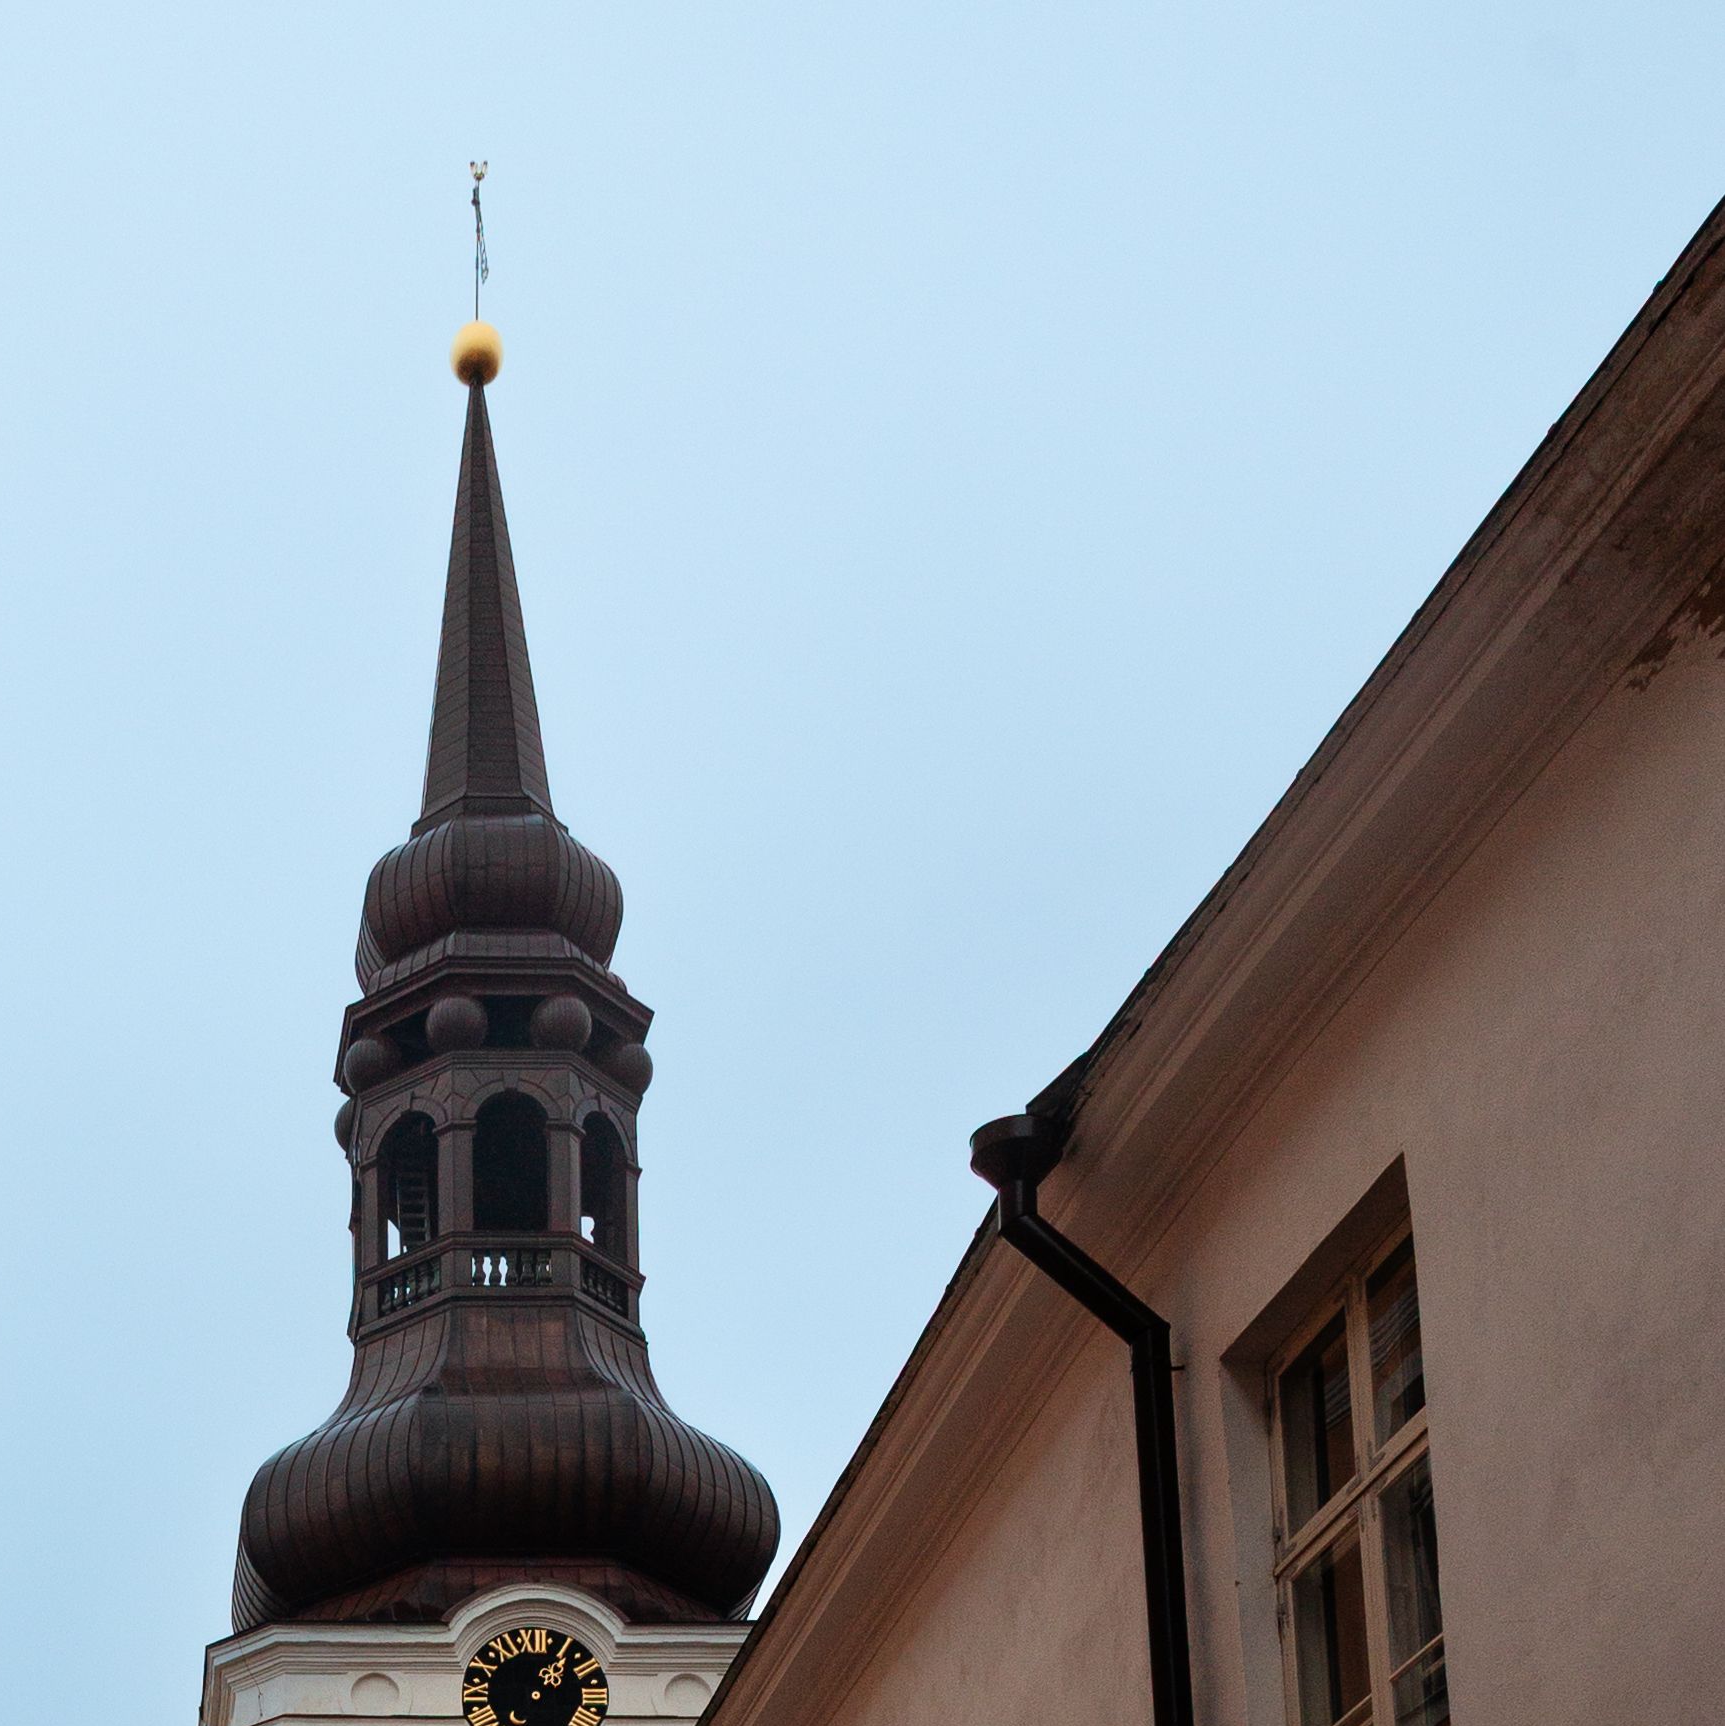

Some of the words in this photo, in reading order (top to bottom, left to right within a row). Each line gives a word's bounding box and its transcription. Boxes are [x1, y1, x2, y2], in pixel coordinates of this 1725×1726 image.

[489, 1633, 519, 1663] XI
[519, 1629, 547, 1654] XII
[556, 1637, 573, 1658] I
[469, 1656, 498, 1678] X
[573, 1658, 600, 1680] II
[463, 1682, 488, 1703] IX
[581, 1687, 608, 1706] III
